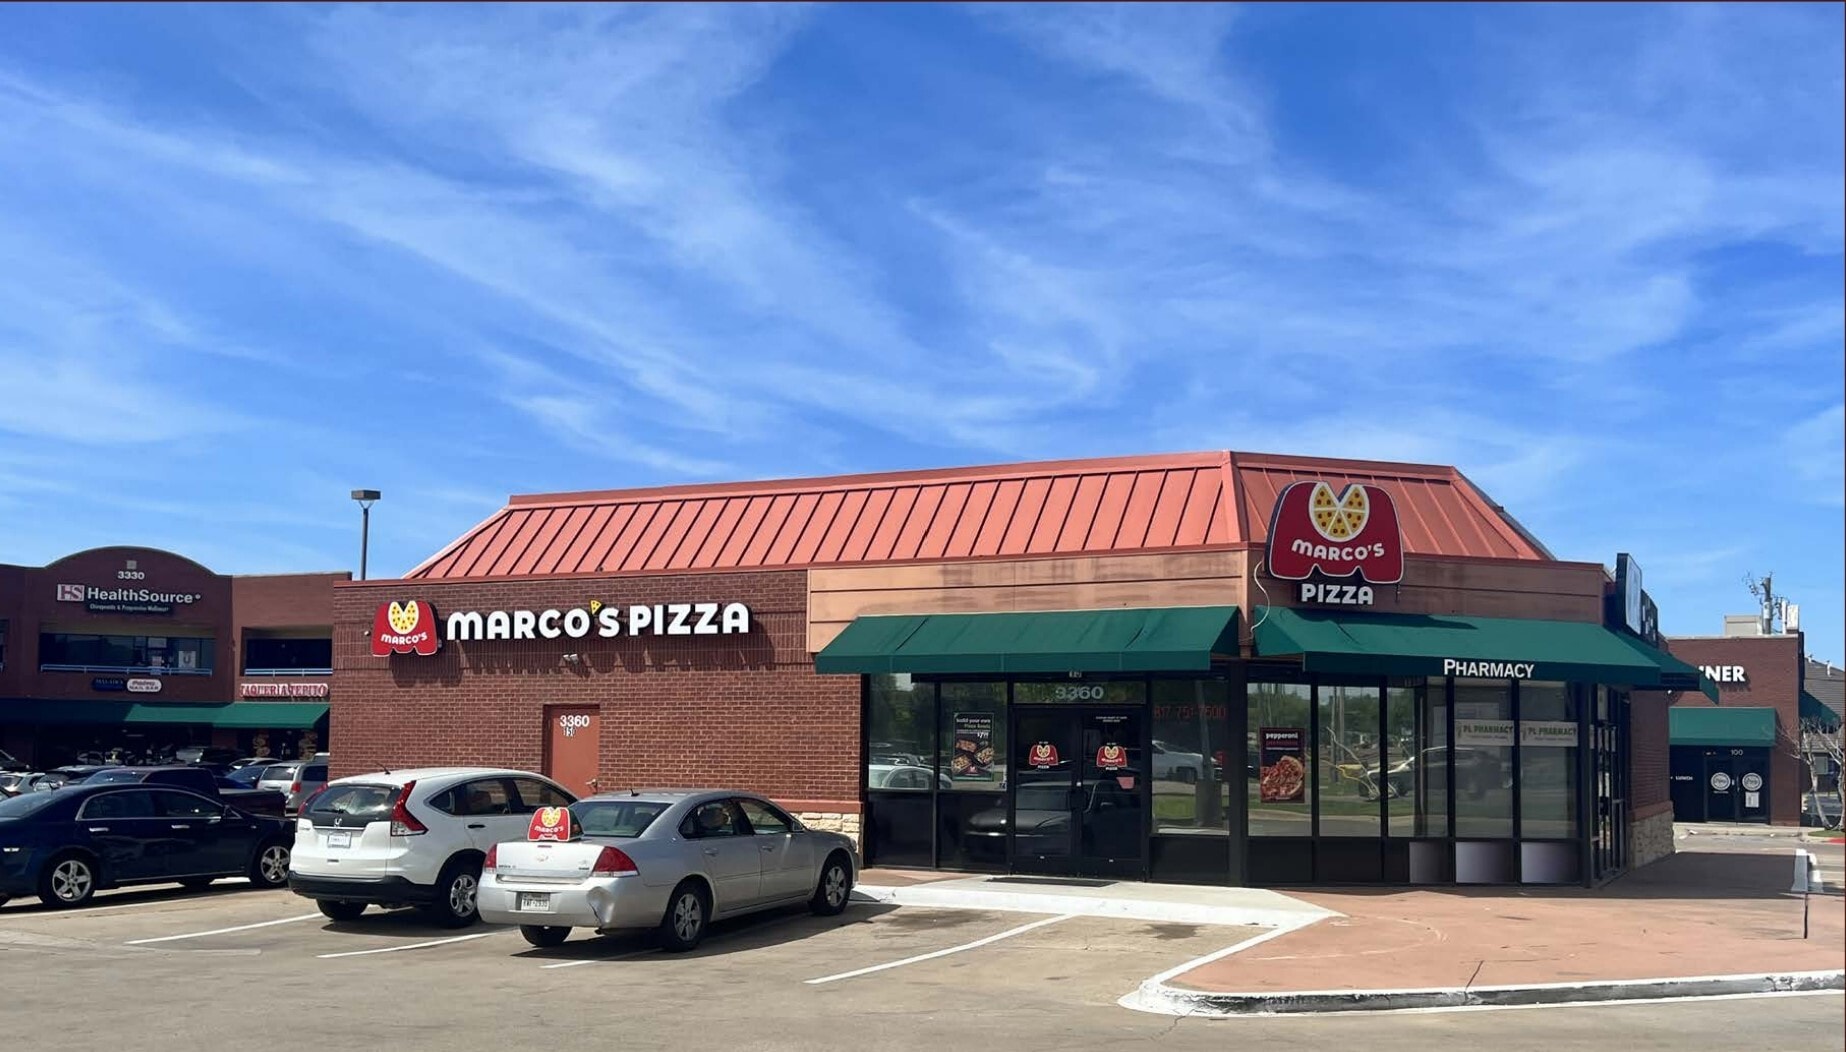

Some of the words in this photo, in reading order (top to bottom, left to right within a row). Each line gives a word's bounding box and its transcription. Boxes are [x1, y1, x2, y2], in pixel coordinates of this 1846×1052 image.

[1291, 539, 1385, 560] MARCO'S
[118, 571, 145, 580] 3330
[1301, 583, 1374, 605] PIZZA
[447, 600, 619, 640] MARCO'S
[629, 602, 749, 636] PIZZA
[381, 633, 428, 645] MARCO'S
[1443, 658, 1535, 678] PHARMACY
[1055, 686, 1105, 700] 3360
[560, 714, 590, 727] 3360
